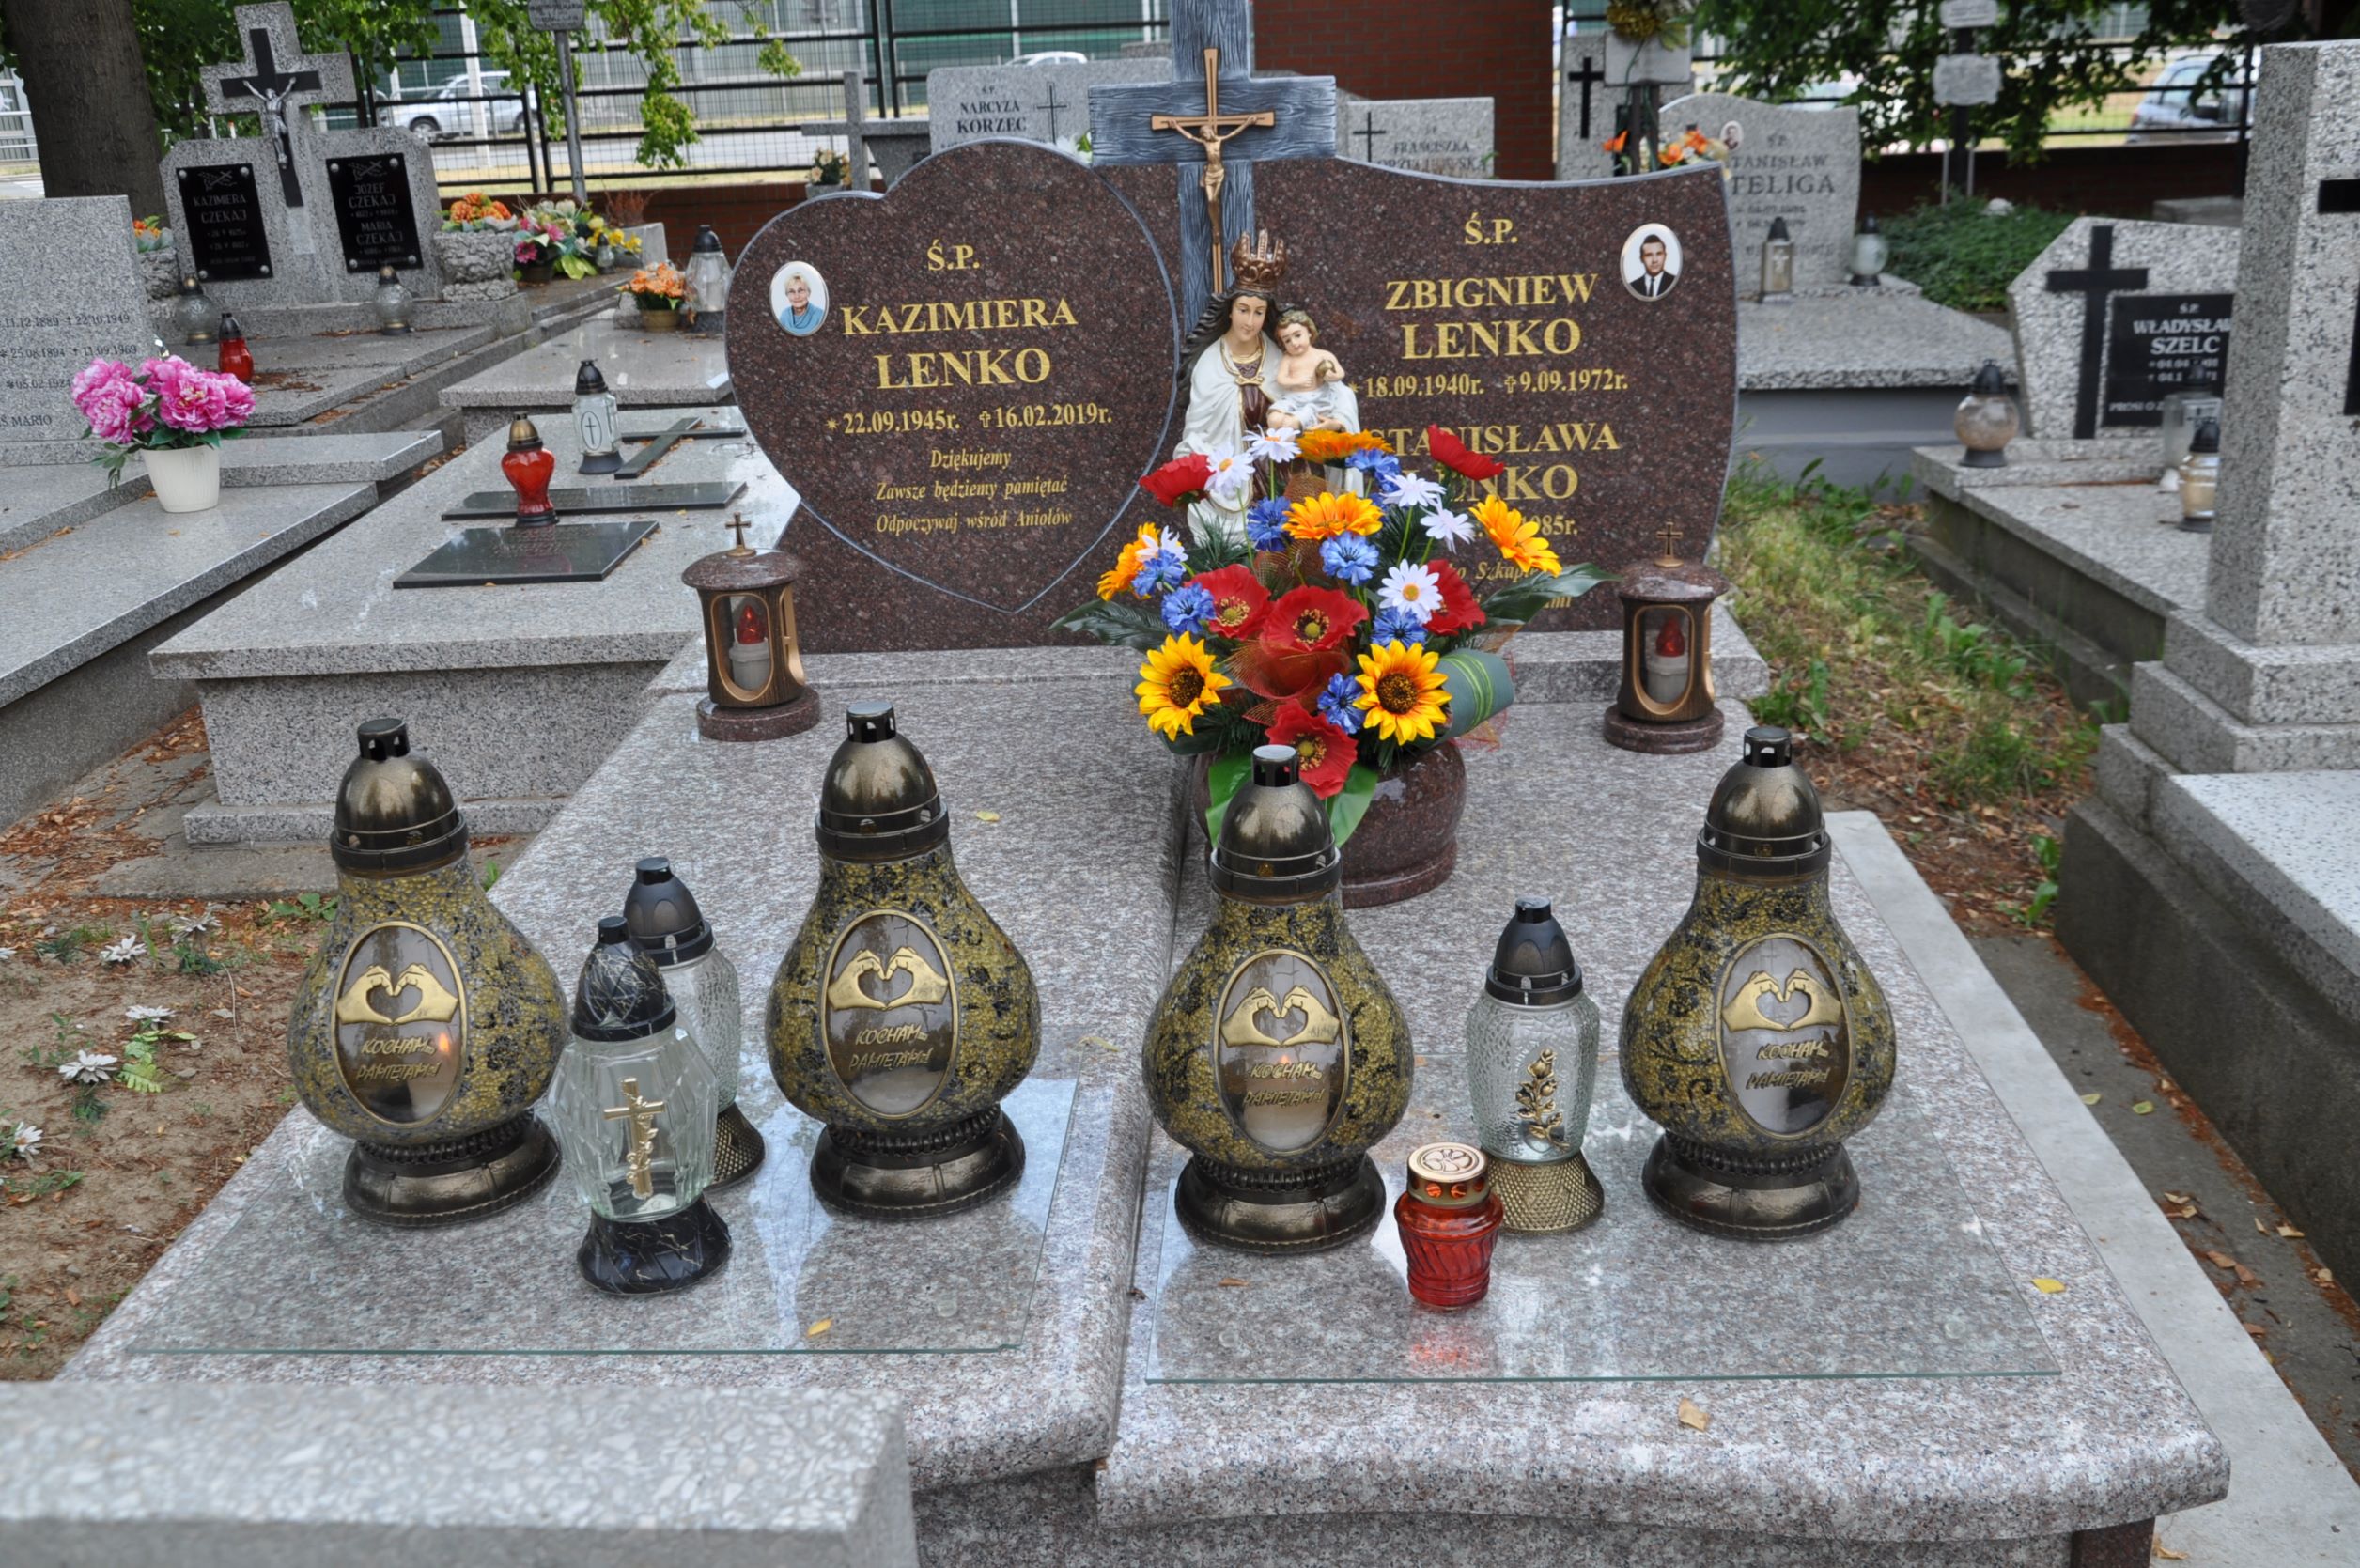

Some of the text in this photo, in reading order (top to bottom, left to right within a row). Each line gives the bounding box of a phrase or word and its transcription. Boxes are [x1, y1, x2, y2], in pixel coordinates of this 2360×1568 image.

[960, 100, 1020, 114] NARCYZA
[956, 116, 1027, 133] KORZEC
[1731, 155, 1828, 169] TANISŁAW
[1731, 175, 1835, 195] TELIGA
[1464, 212, 1518, 245] Ś.P.
[925, 240, 981, 272] Ś.P.
[1384, 273, 1598, 310] ZBIGNIEW
[840, 298, 1079, 335] KAZIMIERA
[1401, 318, 1582, 360] LENKO
[2150, 335, 2221, 355] SZELC
[873, 348, 1051, 390] LENKO
[1365, 368, 1629, 398] 18.09.1940r. 9.09.1972r.
[843, 402, 1112, 434] 22.09.1945r. 16.02.2019r.
[930, 448, 1012, 471] Dziękujemy
[876, 474, 1068, 502] Zawsze będziemy pamiętać
[1402, 464, 1579, 502] NKO
[877, 507, 1073, 536] Odpoczywaj wśród Aniołów
